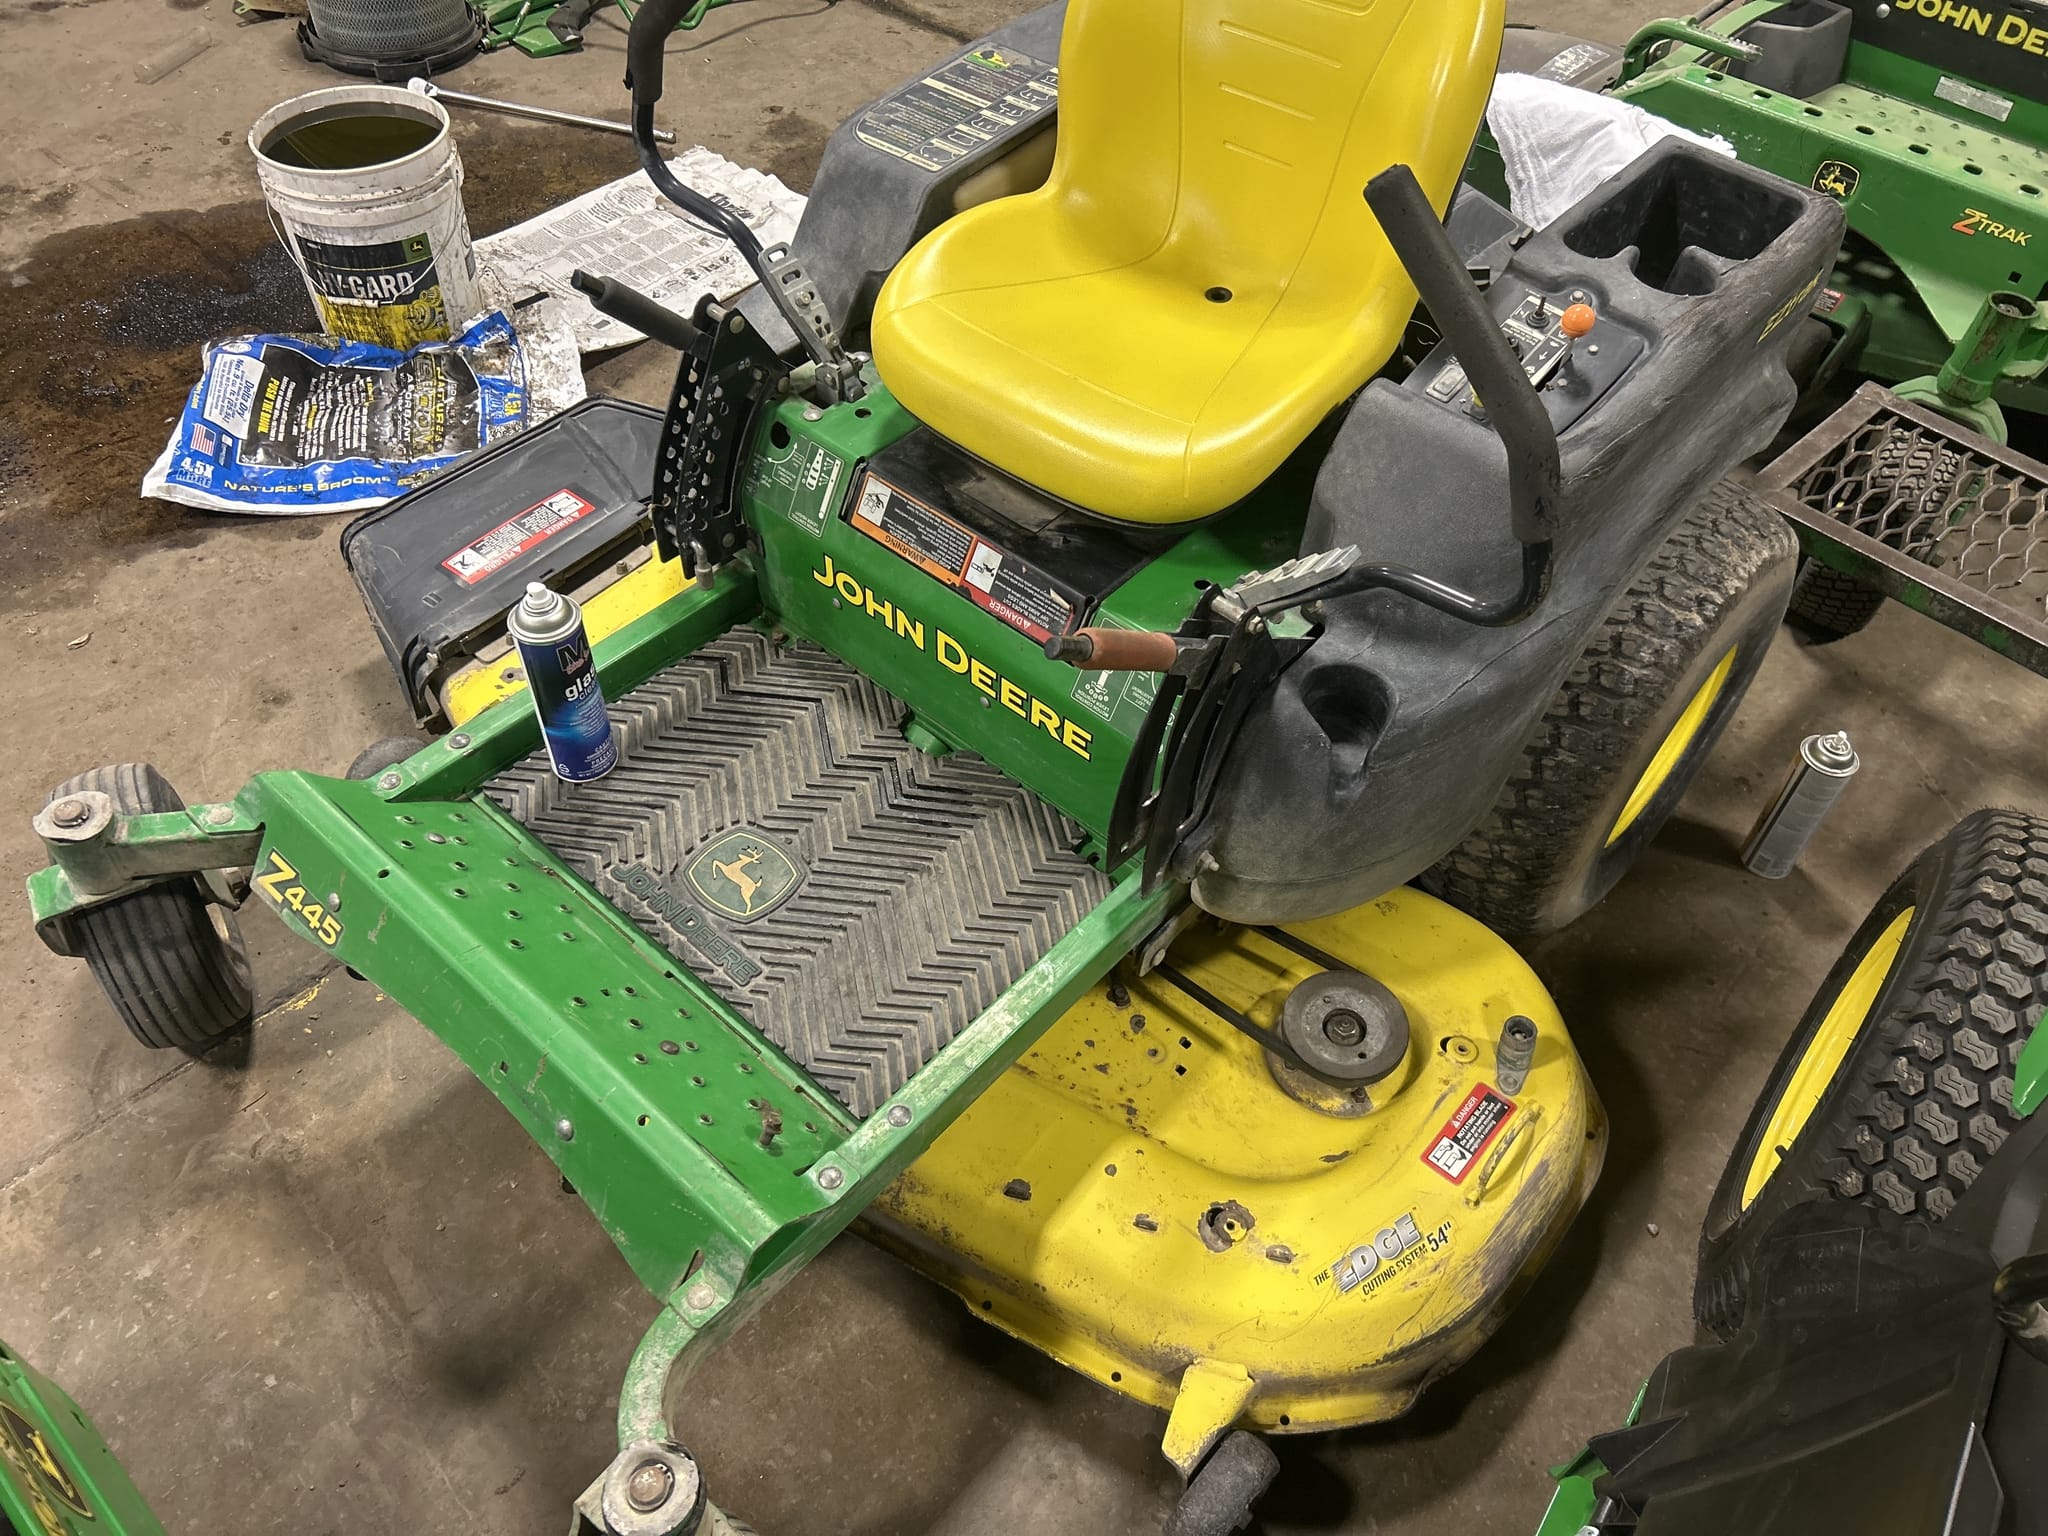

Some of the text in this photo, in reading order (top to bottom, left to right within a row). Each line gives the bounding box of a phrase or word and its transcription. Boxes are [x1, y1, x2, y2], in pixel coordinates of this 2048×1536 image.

[1996, 14, 2048, 57] DE
[234, 379, 255, 420] Delta Dry
[223, 480, 314, 493] NATURE'S
[884, 534, 919, 562] WARNING
[988, 599, 1025, 628] DANGER
[812, 553, 1094, 762] JOHN DEERE
[256, 851, 342, 945] Z445
[610, 861, 763, 988] JOHN DEERE
[1455, 1095, 1479, 1122] DANGER
[1456, 1098, 1488, 1142] ROTATING BLADE
[1313, 1211, 1422, 1293] THE EDGE
[1362, 1221, 1452, 1296] CUTTING SYSTEM 54"
